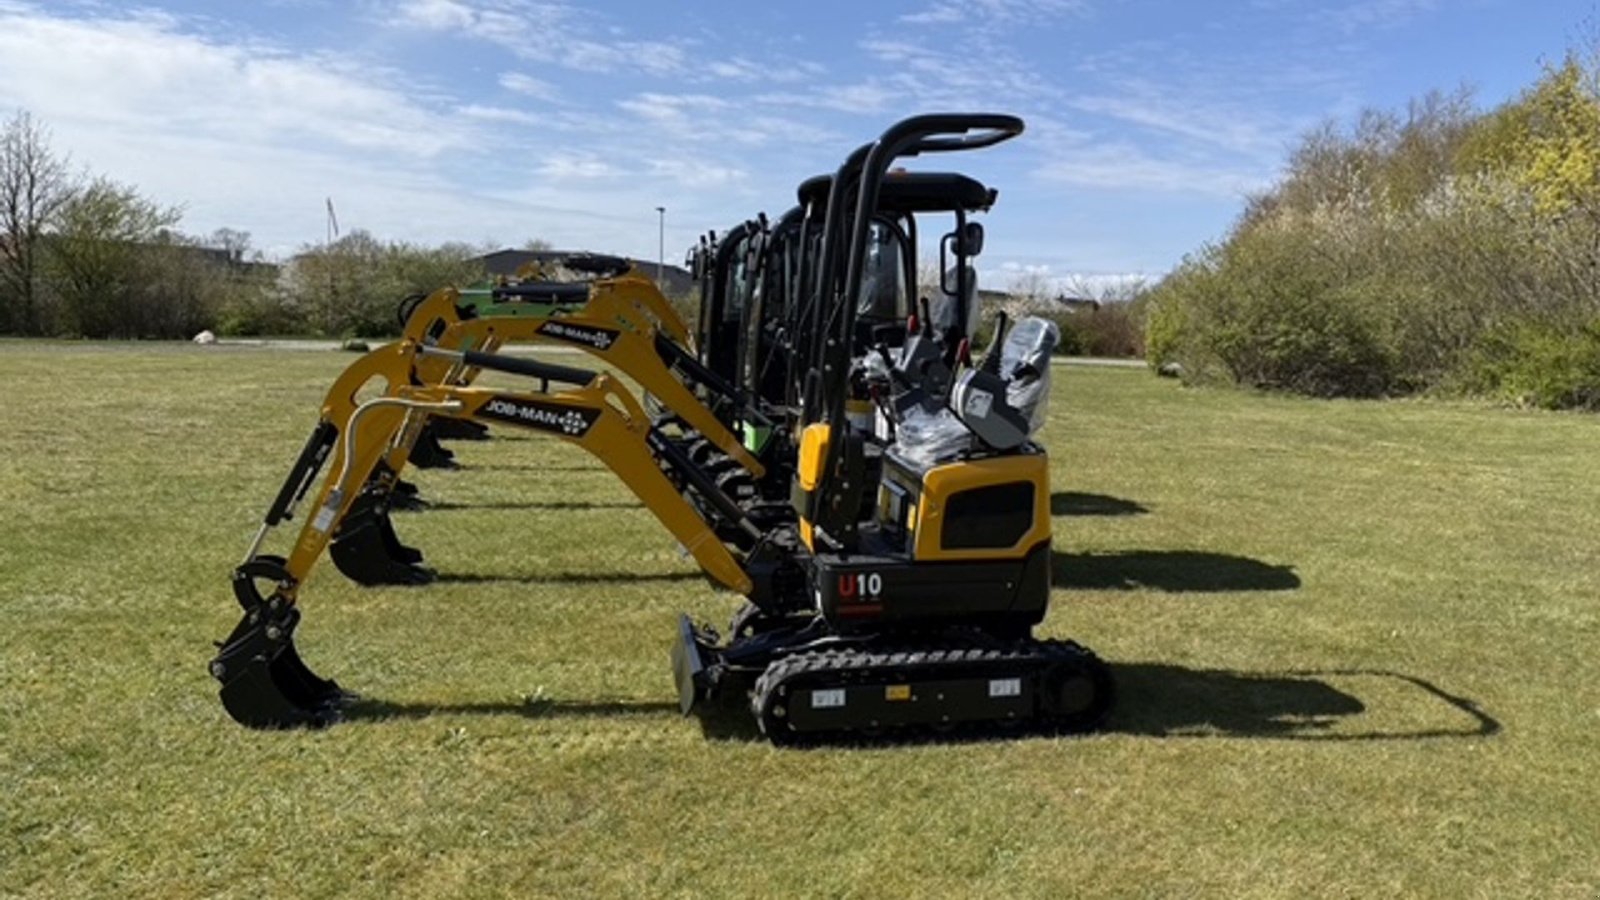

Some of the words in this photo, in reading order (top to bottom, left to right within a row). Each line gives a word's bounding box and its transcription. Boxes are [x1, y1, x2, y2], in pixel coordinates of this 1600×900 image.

[543, 323, 591, 341] JOB-MAN
[486, 400, 558, 425] JOB-MAN
[839, 573, 882, 596] U10
